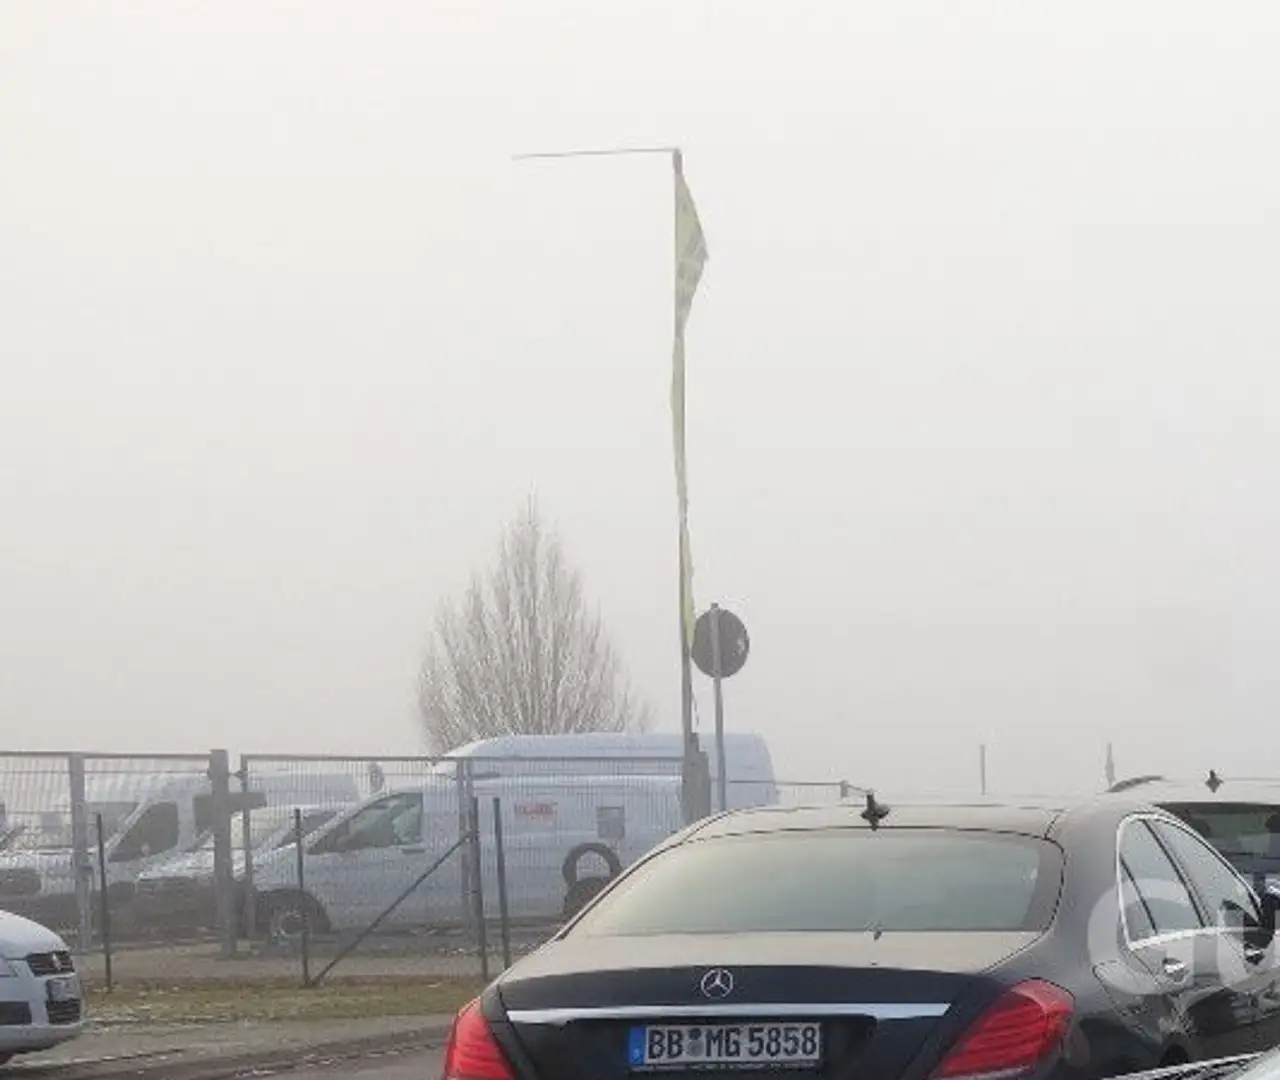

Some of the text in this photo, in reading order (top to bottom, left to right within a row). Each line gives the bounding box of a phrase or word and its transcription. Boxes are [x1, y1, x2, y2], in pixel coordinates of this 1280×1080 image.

[649, 1028, 817, 1059] BB MG 5858
